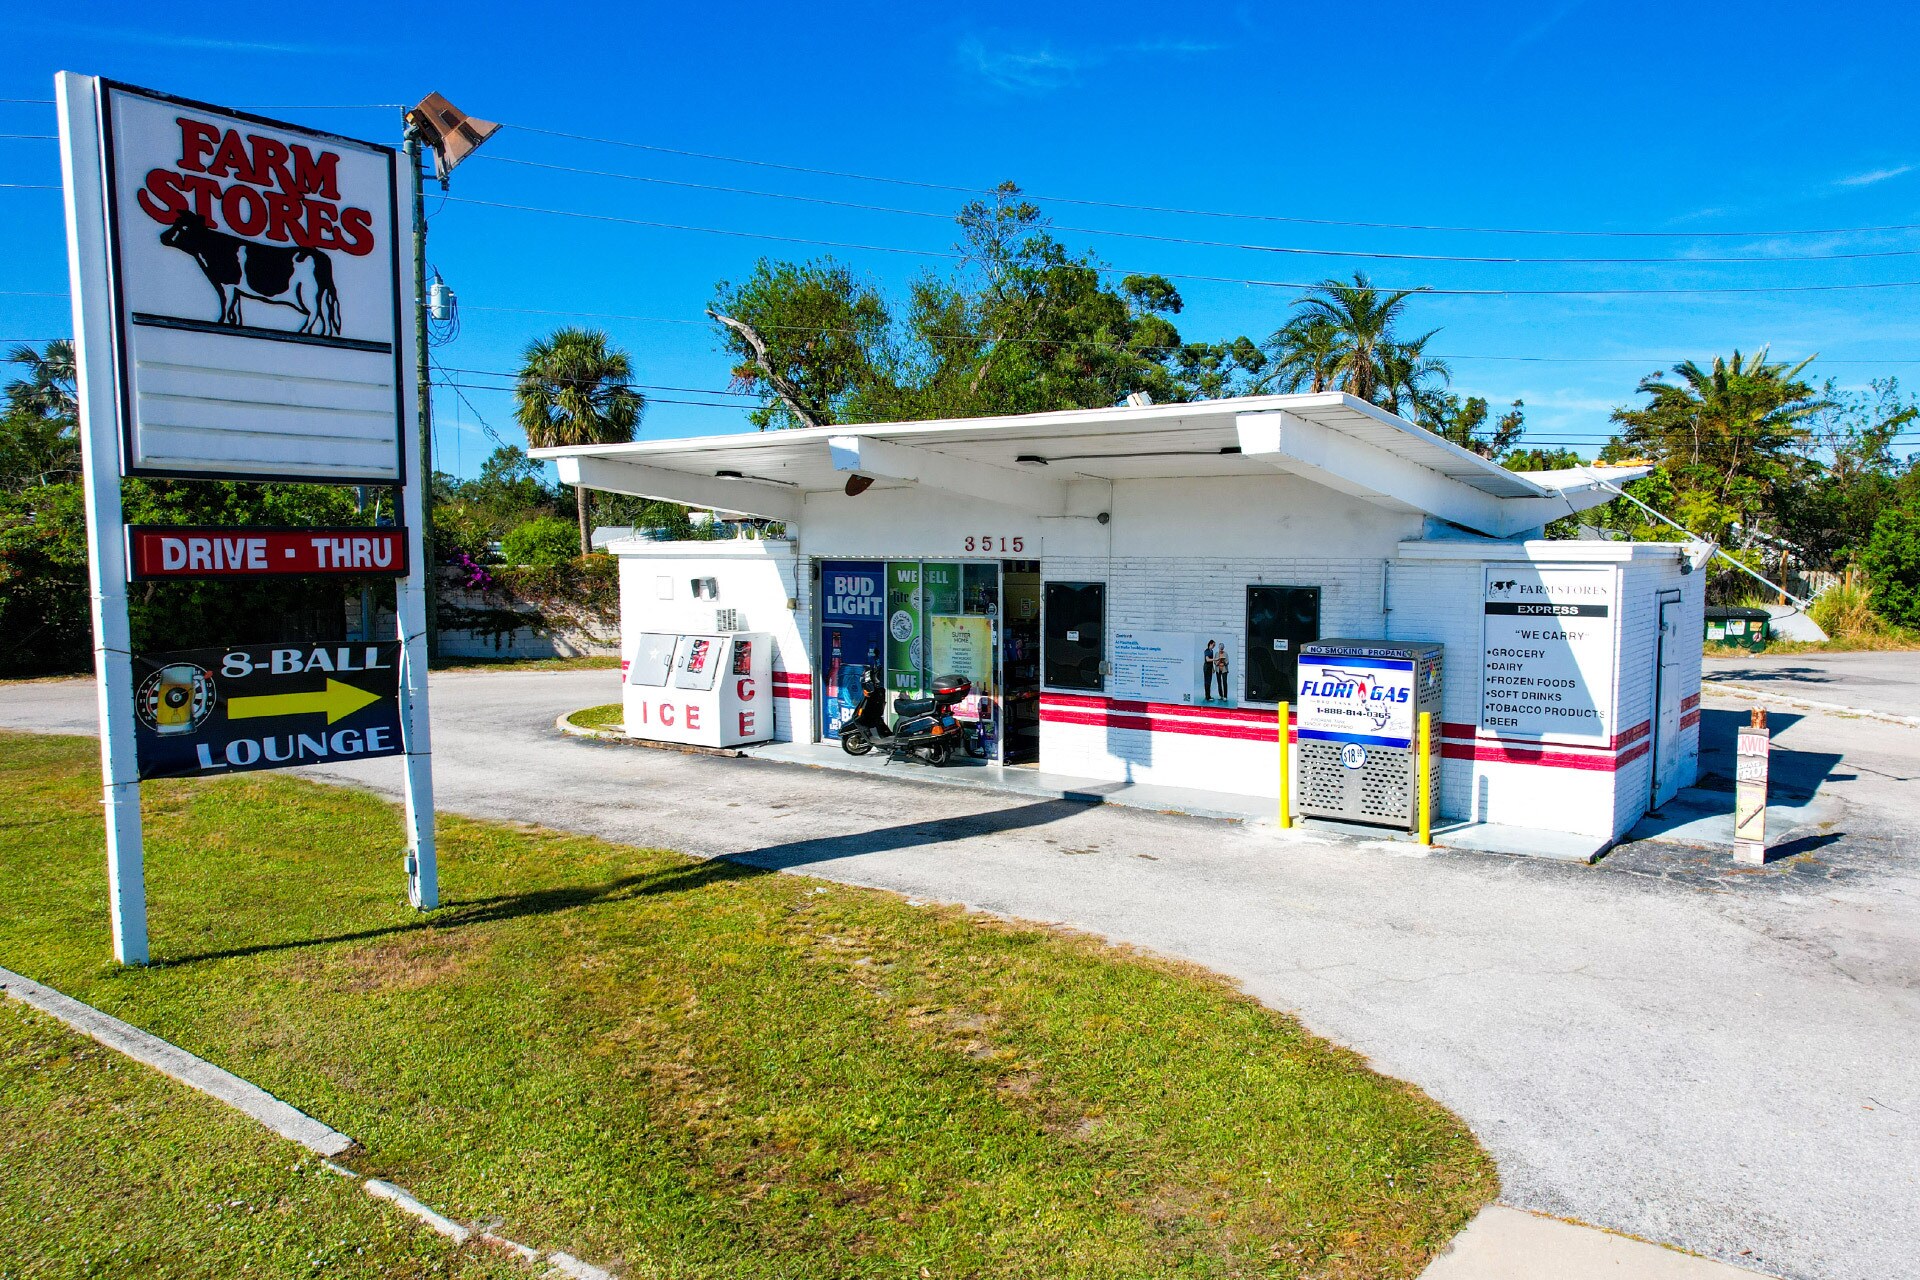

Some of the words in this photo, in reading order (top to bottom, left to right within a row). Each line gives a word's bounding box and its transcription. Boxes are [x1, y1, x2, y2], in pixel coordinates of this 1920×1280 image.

[177, 117, 341, 200] FARM
[137, 168, 374, 256] STORES
[162, 537, 268, 570] DRIVE
[311, 537, 392, 568] THRU
[965, 536, 1024, 553] 3515
[897, 569, 918, 583] WE
[923, 570, 949, 584] SELL
[834, 577, 875, 597] BUD
[827, 596, 882, 616] LIGHT
[1517, 605, 1579, 615] EXPRESS
[1325, 647, 1364, 655] SMOKING
[1368, 649, 1407, 657] PROPANE
[220, 646, 391, 678] 8-BALL
[896, 673, 917, 688] WE
[1537, 678, 1576, 688] FOODS
[1521, 691, 1562, 701] DRINKS
[642, 701, 700, 730] ICE
[737, 678, 756, 737] CE
[1316, 707, 1391, 720] 1-888-814-0365
[1544, 706, 1605, 719] PRODUCTS
[196, 725, 394, 770] LOUNGE
